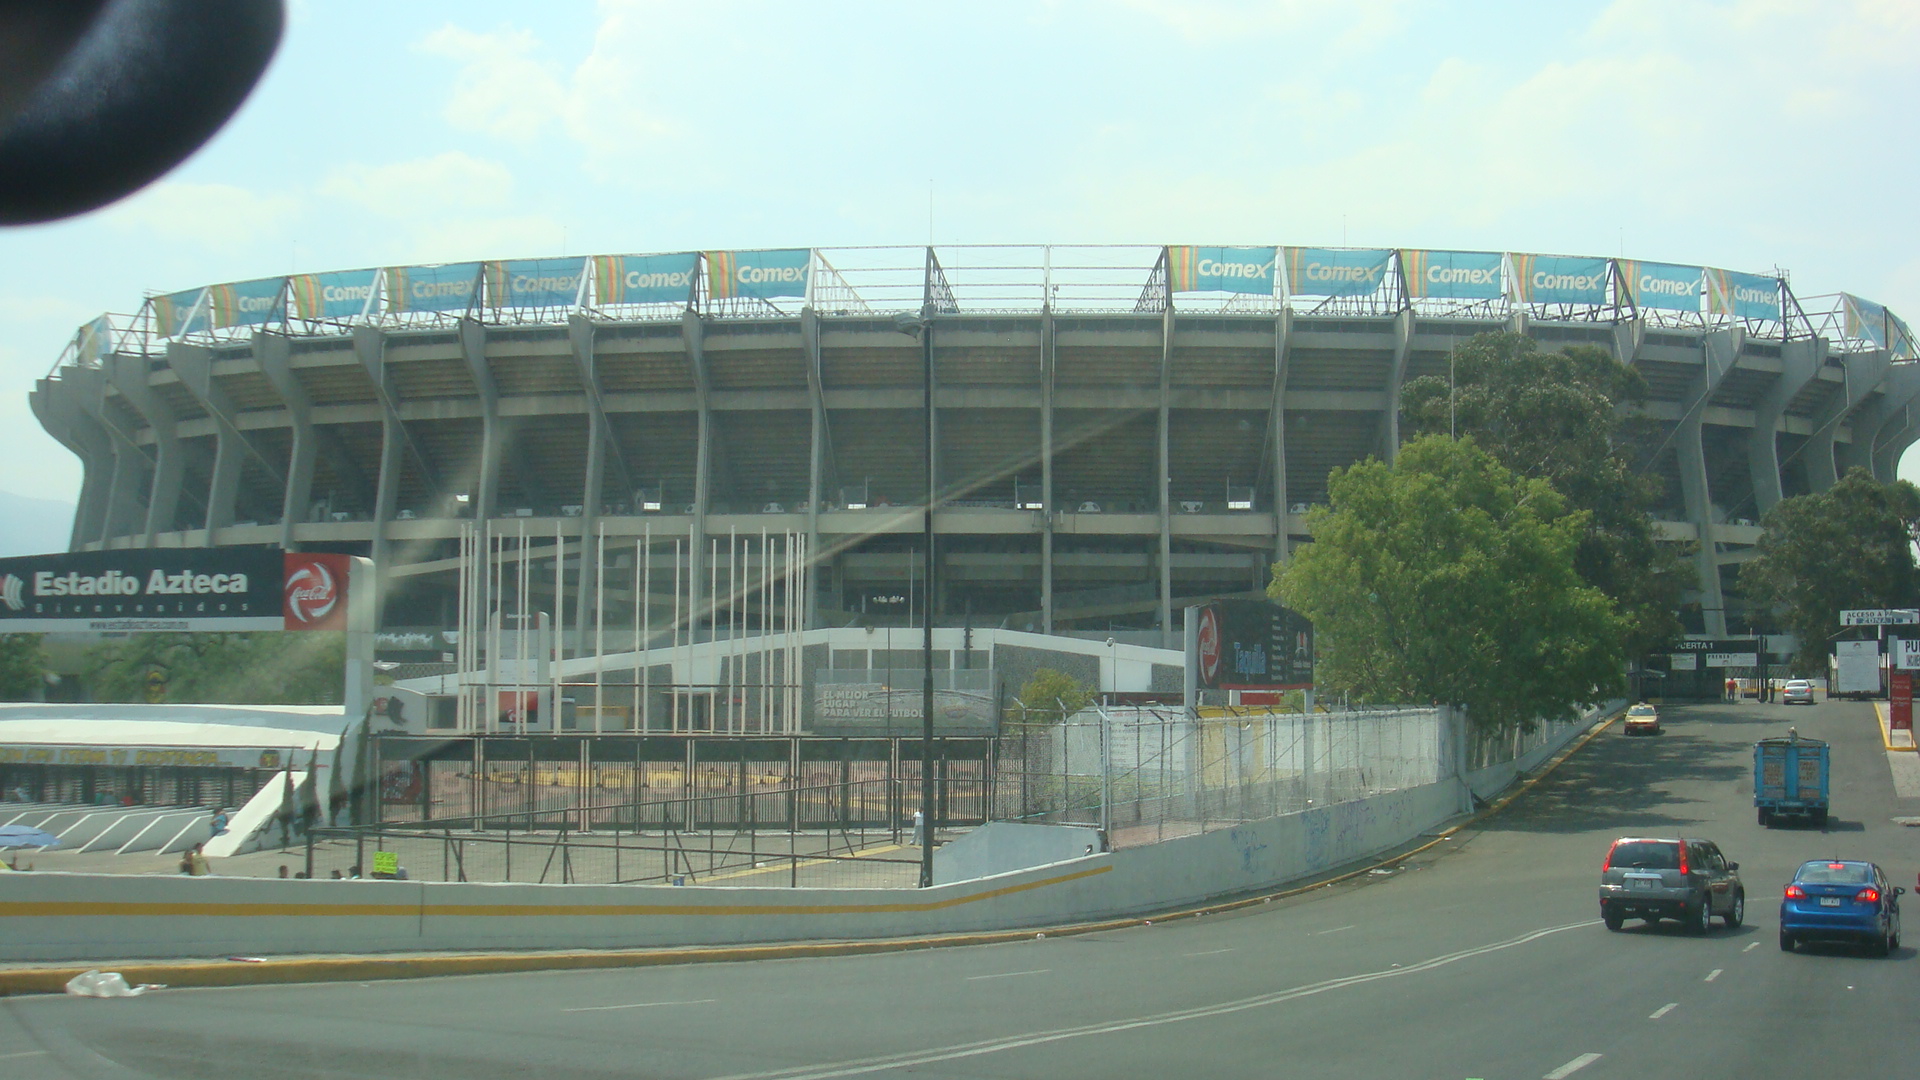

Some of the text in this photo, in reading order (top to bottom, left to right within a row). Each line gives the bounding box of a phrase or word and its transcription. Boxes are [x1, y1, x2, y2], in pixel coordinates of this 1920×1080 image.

[624, 268, 695, 289] Comex
[737, 264, 809, 284] Comex
[1197, 258, 1274, 279] Comex
[1306, 262, 1384, 283] Comex
[1426, 264, 1500, 285] Comex
[411, 277, 475, 298] Comex
[512, 270, 584, 293] Comex
[1532, 271, 1605, 291] Comex
[1639, 274, 1701, 297] Comex
[1733, 284, 1779, 306] Comex
[35, 569, 248, 596] Estadio Azteca
[1233, 642, 1266, 681] Taquilla
[823, 690, 869, 699] EL MEJOR
[823, 709, 853, 717] PARA
[853, 709, 872, 717] VER
[873, 709, 886, 717] EL
